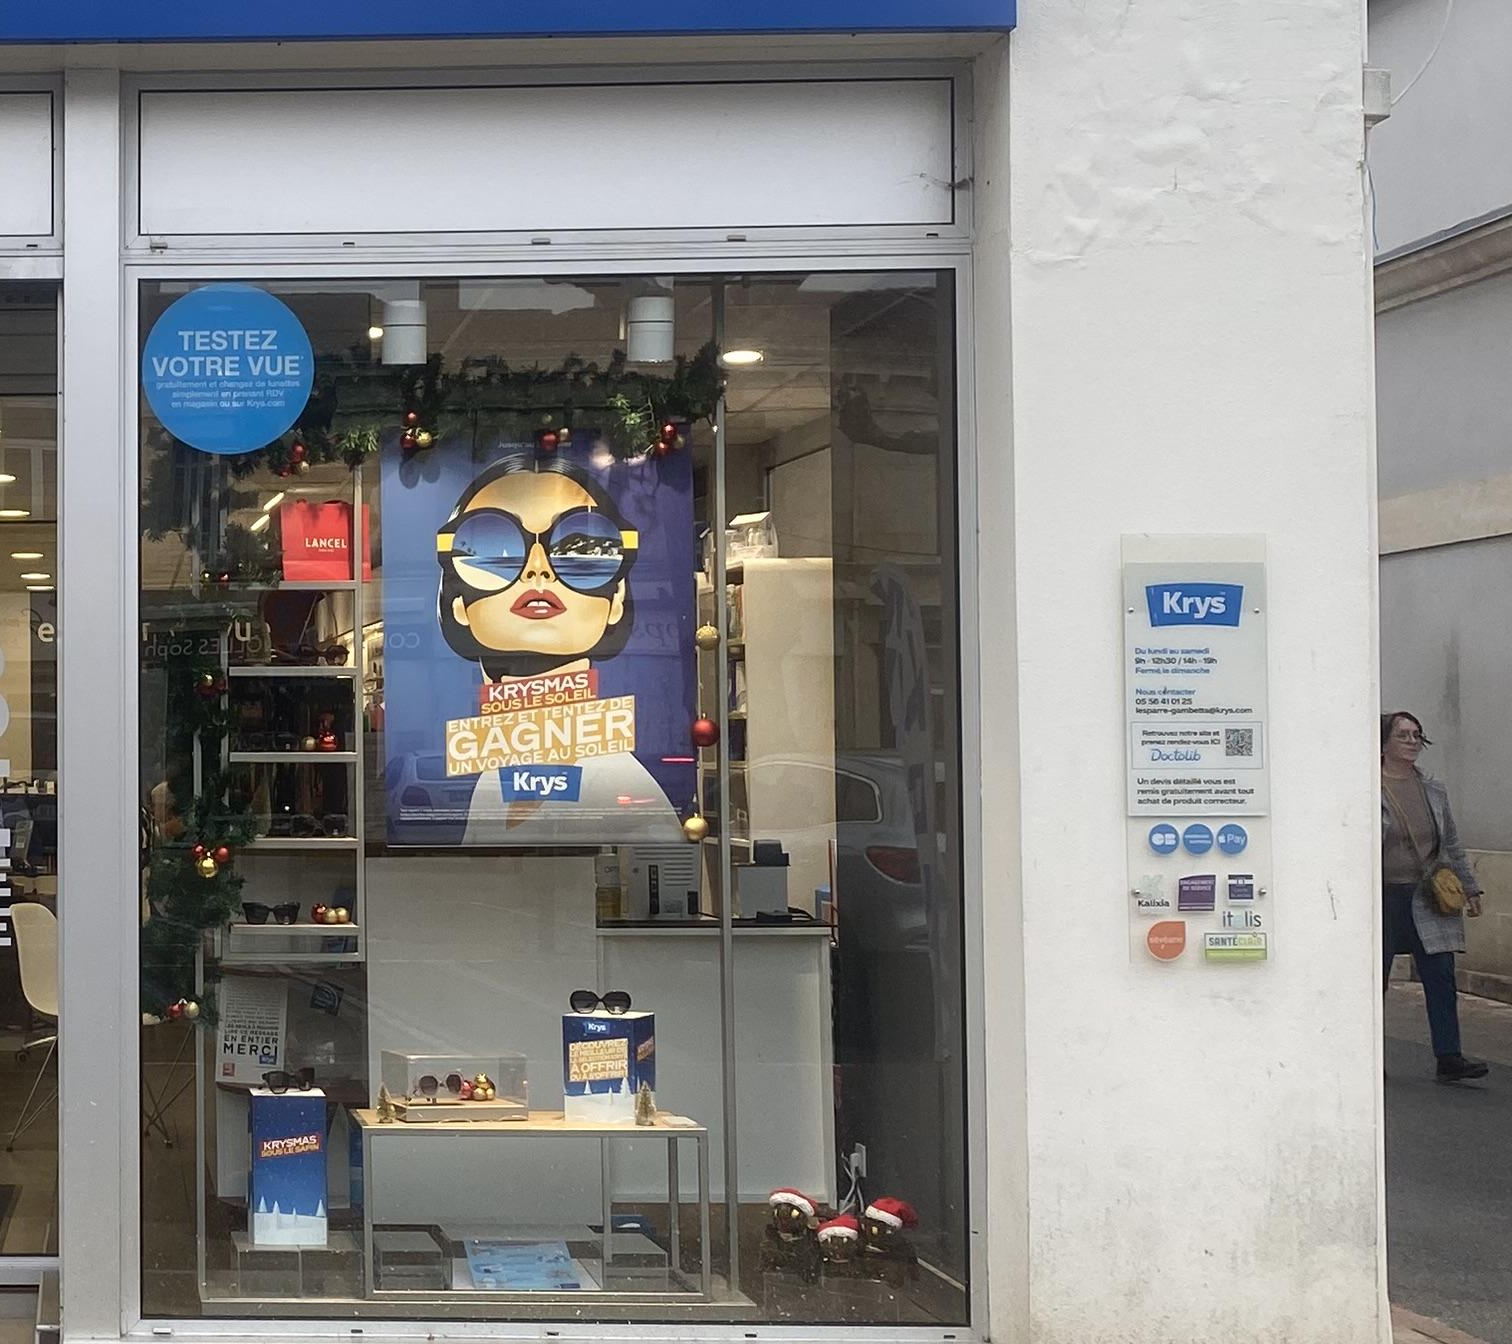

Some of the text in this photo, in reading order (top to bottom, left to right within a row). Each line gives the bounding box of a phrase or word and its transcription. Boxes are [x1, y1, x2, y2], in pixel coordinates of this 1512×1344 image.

[178, 329, 278, 351] TESTEZ
[152, 356, 240, 377] VOTRE
[304, 537, 348, 549] LANCEL
[1162, 591, 1226, 619] Krys
[489, 673, 589, 702] KRYSMAS
[1157, 687, 1196, 695] contacter
[481, 688, 597, 715] SOUS LE SOLEIL
[448, 696, 634, 733] ENTREZ ET TENTEZ DE
[1135, 707, 1253, 715] lesparre-gambetta@krys.com
[448, 709, 634, 762] GAGNER
[448, 740, 635, 775] UN VOYAGE AU SOLEIL
[1151, 748, 1202, 761] Doctolib
[513, 771, 568, 796] Krys
[1161, 788, 1213, 796] gratuitement
[1173, 798, 1202, 806] produit
[1227, 833, 1246, 846] Pay
[1137, 898, 1170, 908] Kalixia
[587, 1022, 607, 1033] Krys
[224, 1035, 279, 1045] EN ENTIER
[223, 1042, 278, 1057] MERCI
[581, 1059, 628, 1074] OFFRIR
[263, 1135, 317, 1151] KRYSMAS
